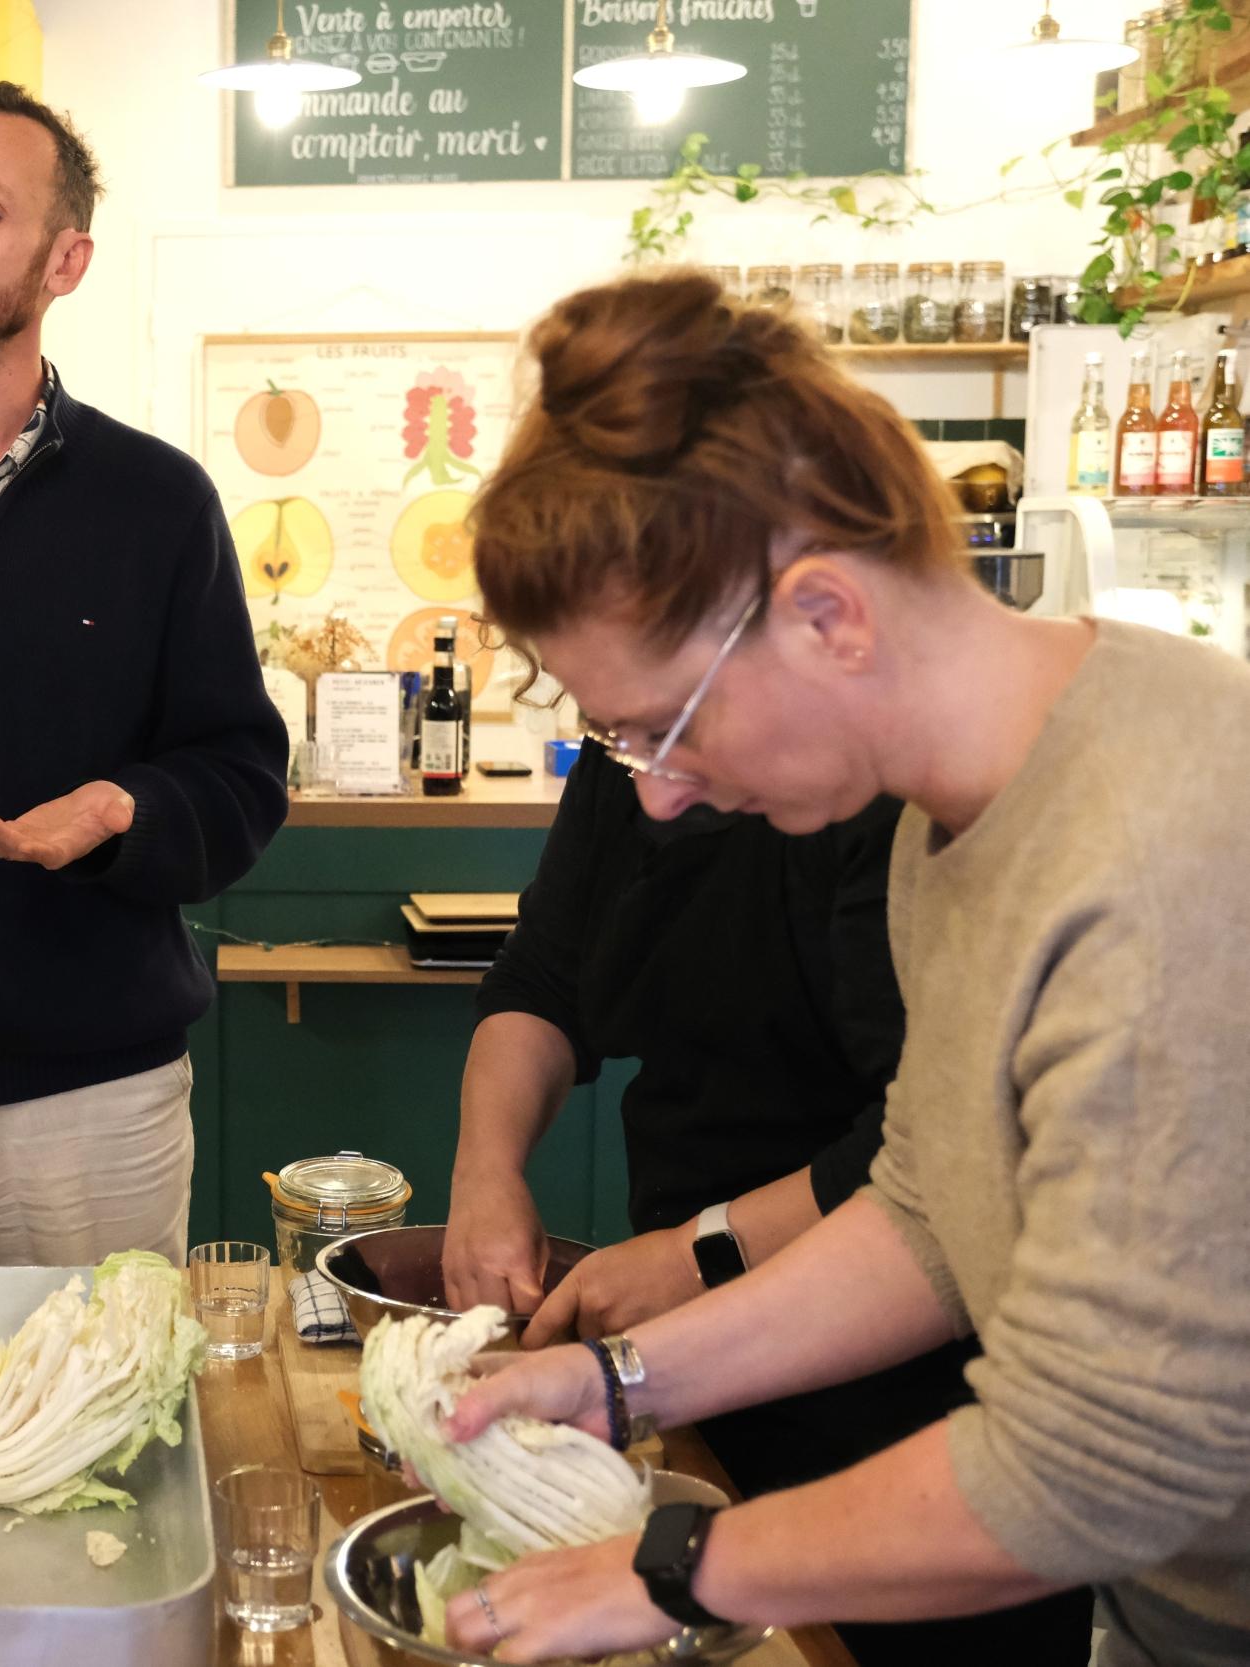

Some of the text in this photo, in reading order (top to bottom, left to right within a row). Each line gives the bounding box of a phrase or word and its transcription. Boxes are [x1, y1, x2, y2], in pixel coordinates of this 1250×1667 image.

[296, 1, 512, 36] Vente à emporter
[297, 76, 468, 118] mmande au
[437, 120, 526, 156] merci
